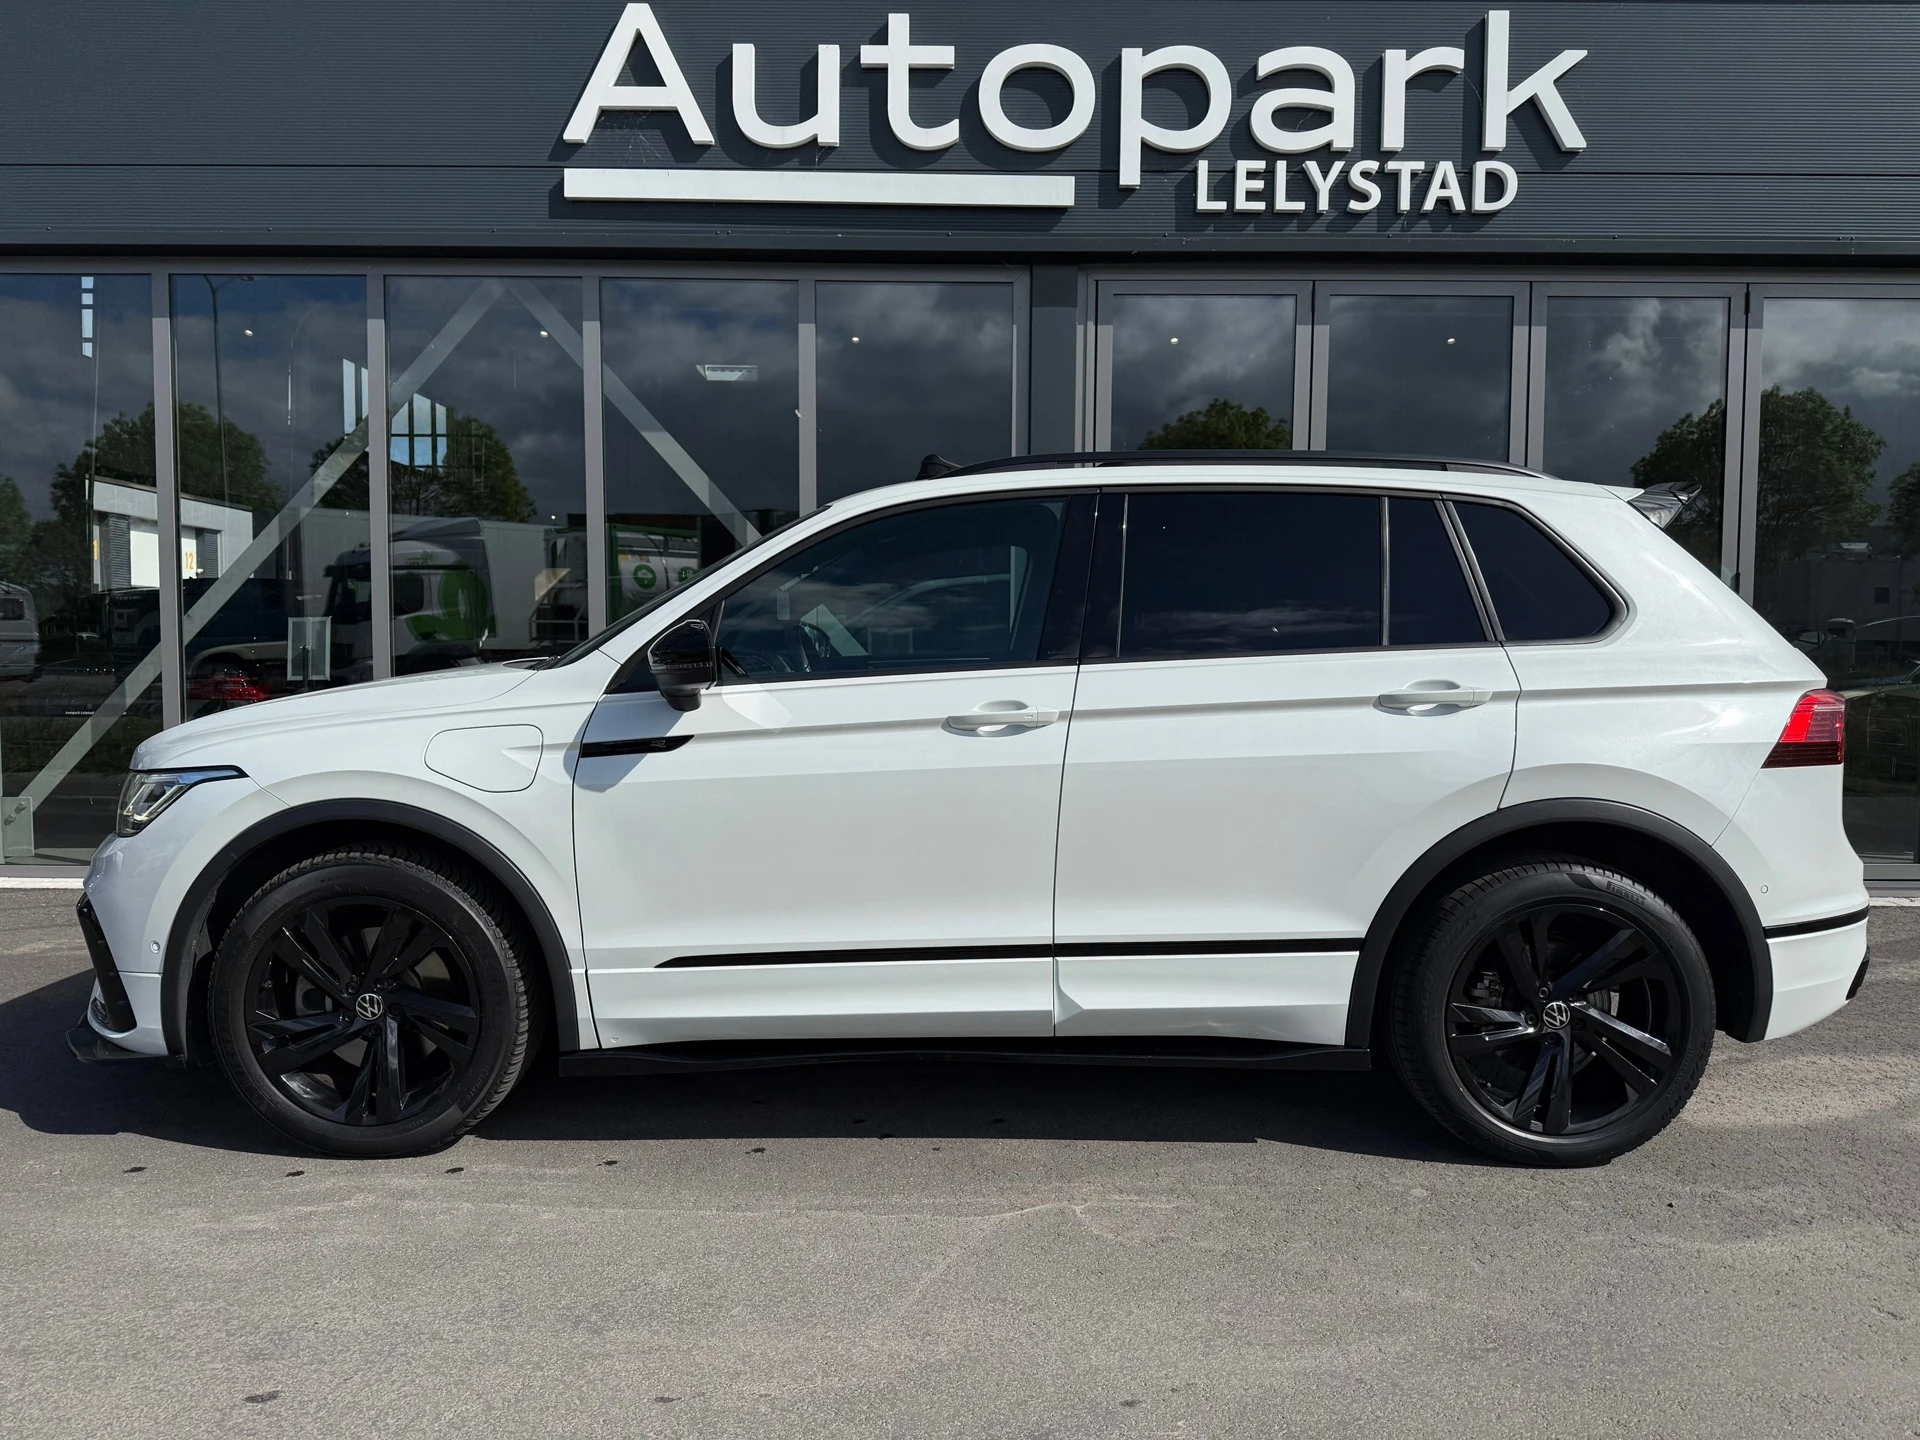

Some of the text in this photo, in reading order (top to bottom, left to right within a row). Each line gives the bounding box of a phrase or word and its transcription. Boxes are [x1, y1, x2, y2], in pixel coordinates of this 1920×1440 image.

[563, 2, 1588, 190] Autopark
[1195, 159, 1520, 214] LELYSTAD
[355, 993, 383, 1020] VW
[1543, 1002, 1570, 1029] VW
